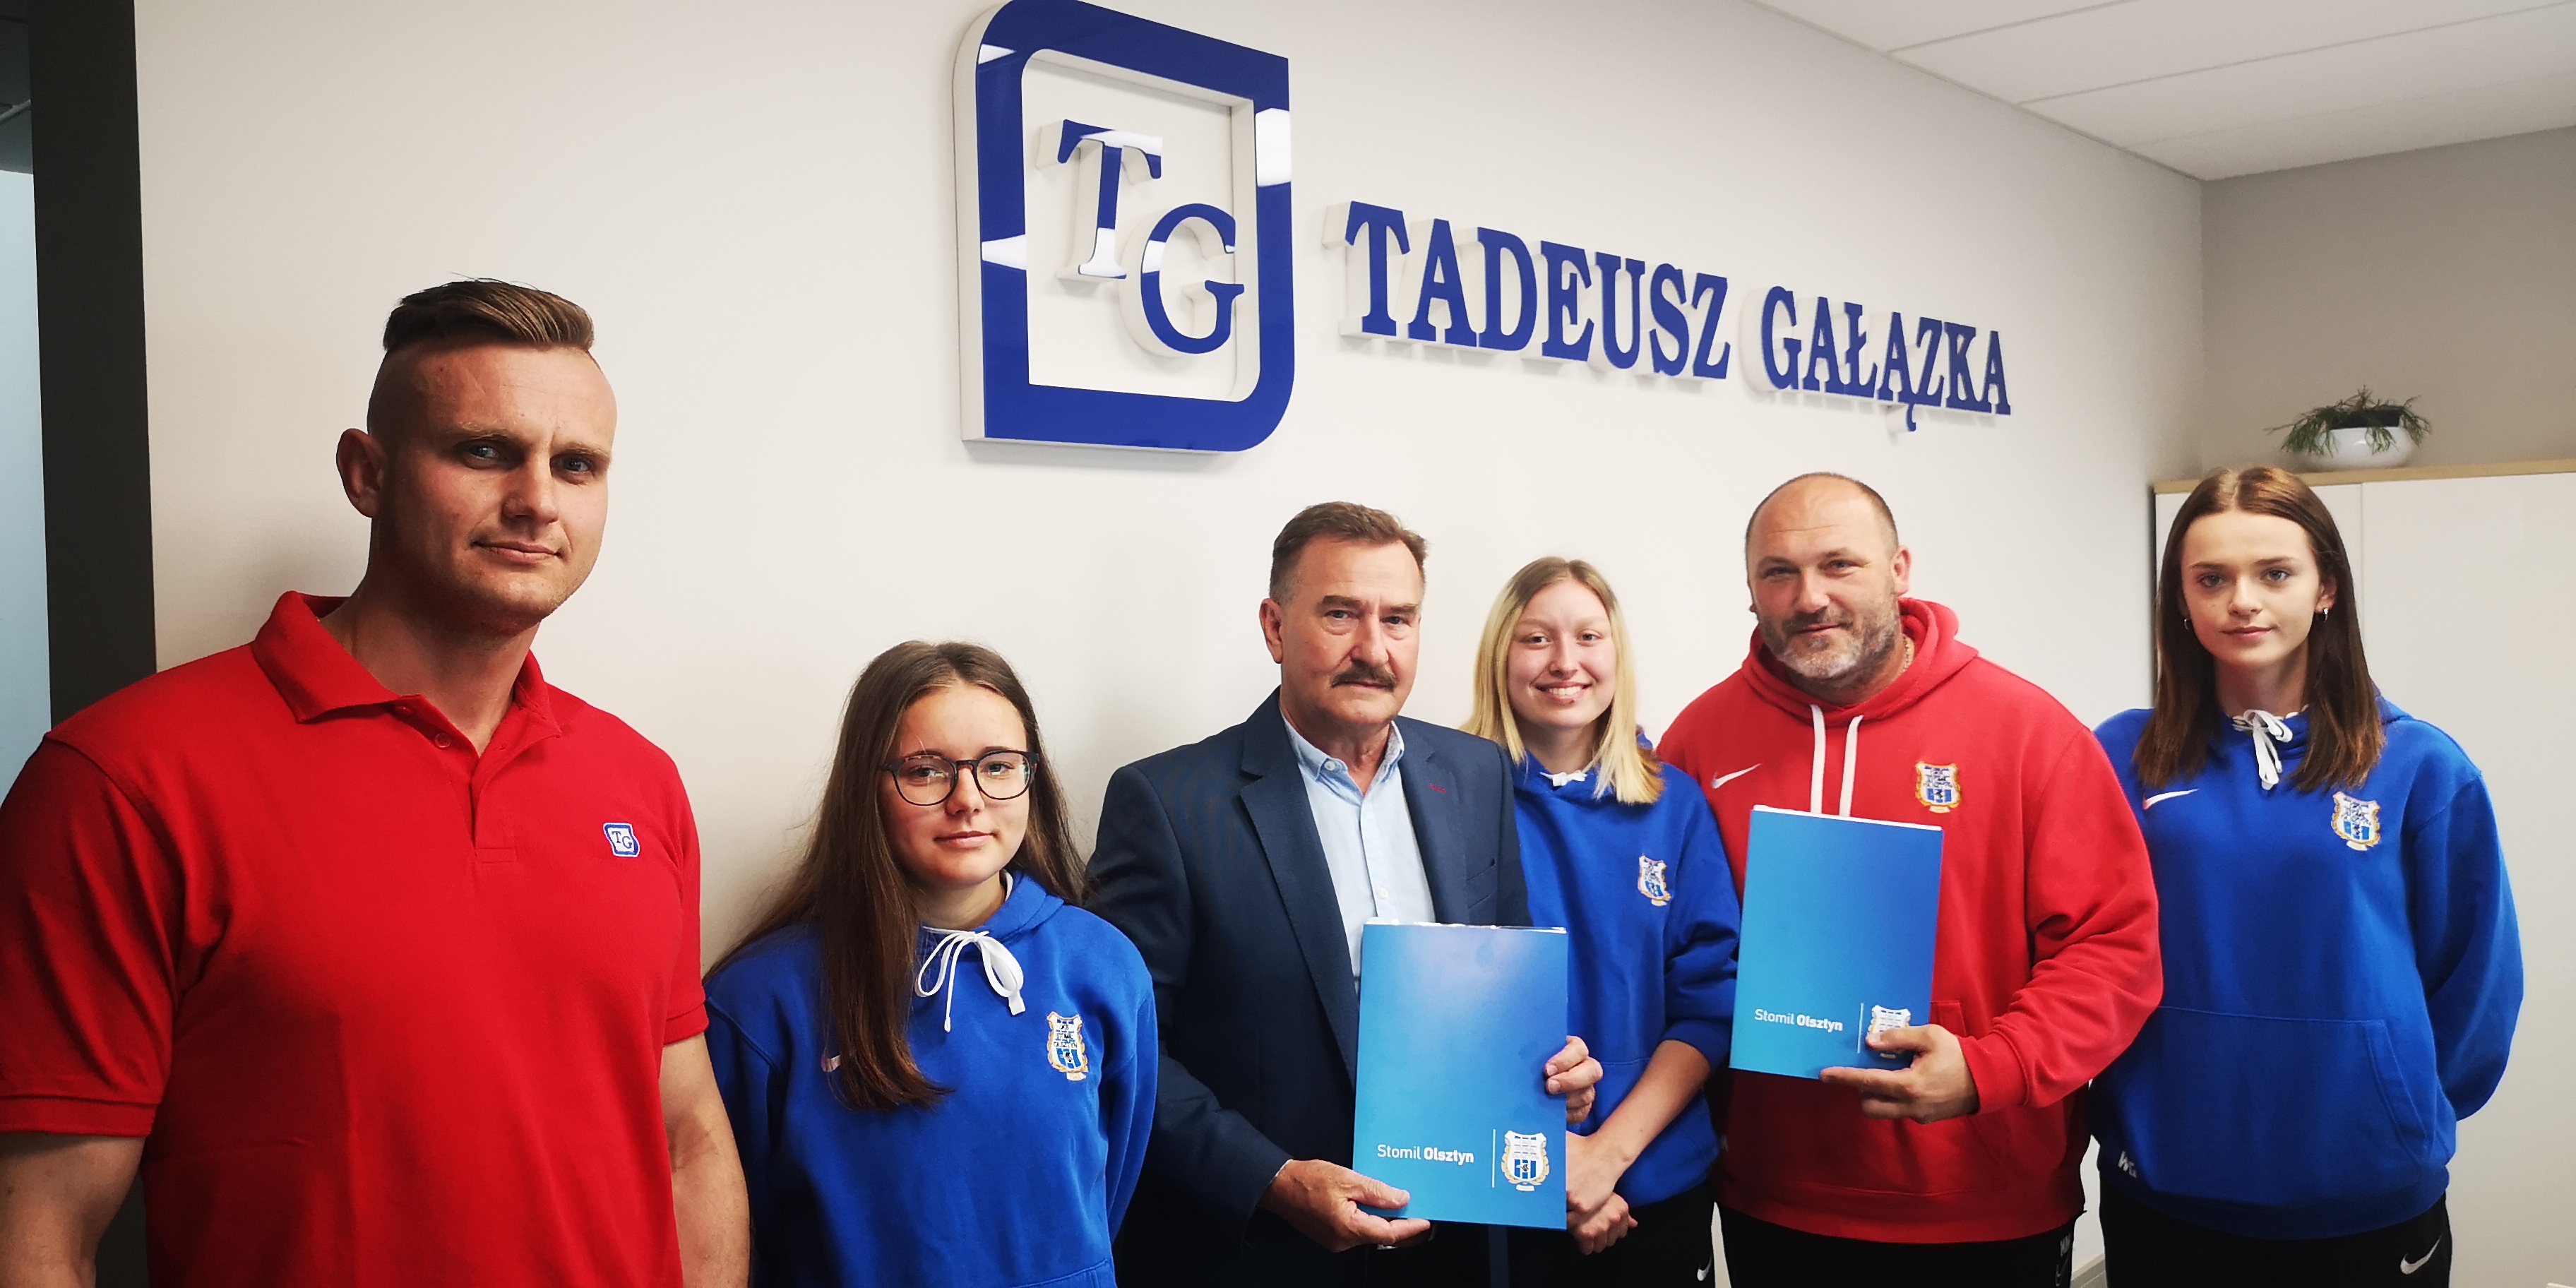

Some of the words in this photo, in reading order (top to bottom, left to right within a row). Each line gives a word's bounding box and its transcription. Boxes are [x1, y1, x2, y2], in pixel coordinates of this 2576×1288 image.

[1345, 201, 1731, 379] TADEUSZ
[1761, 286, 2011, 432] GAŁĄZKA
[612, 831, 633, 849] TG
[1755, 1008, 1794, 1025] Stomil
[1796, 1014, 1843, 1033] Olsztyn
[1377, 1144, 1421, 1160] Stomil
[1424, 1147, 1474, 1166] Olsztyn
